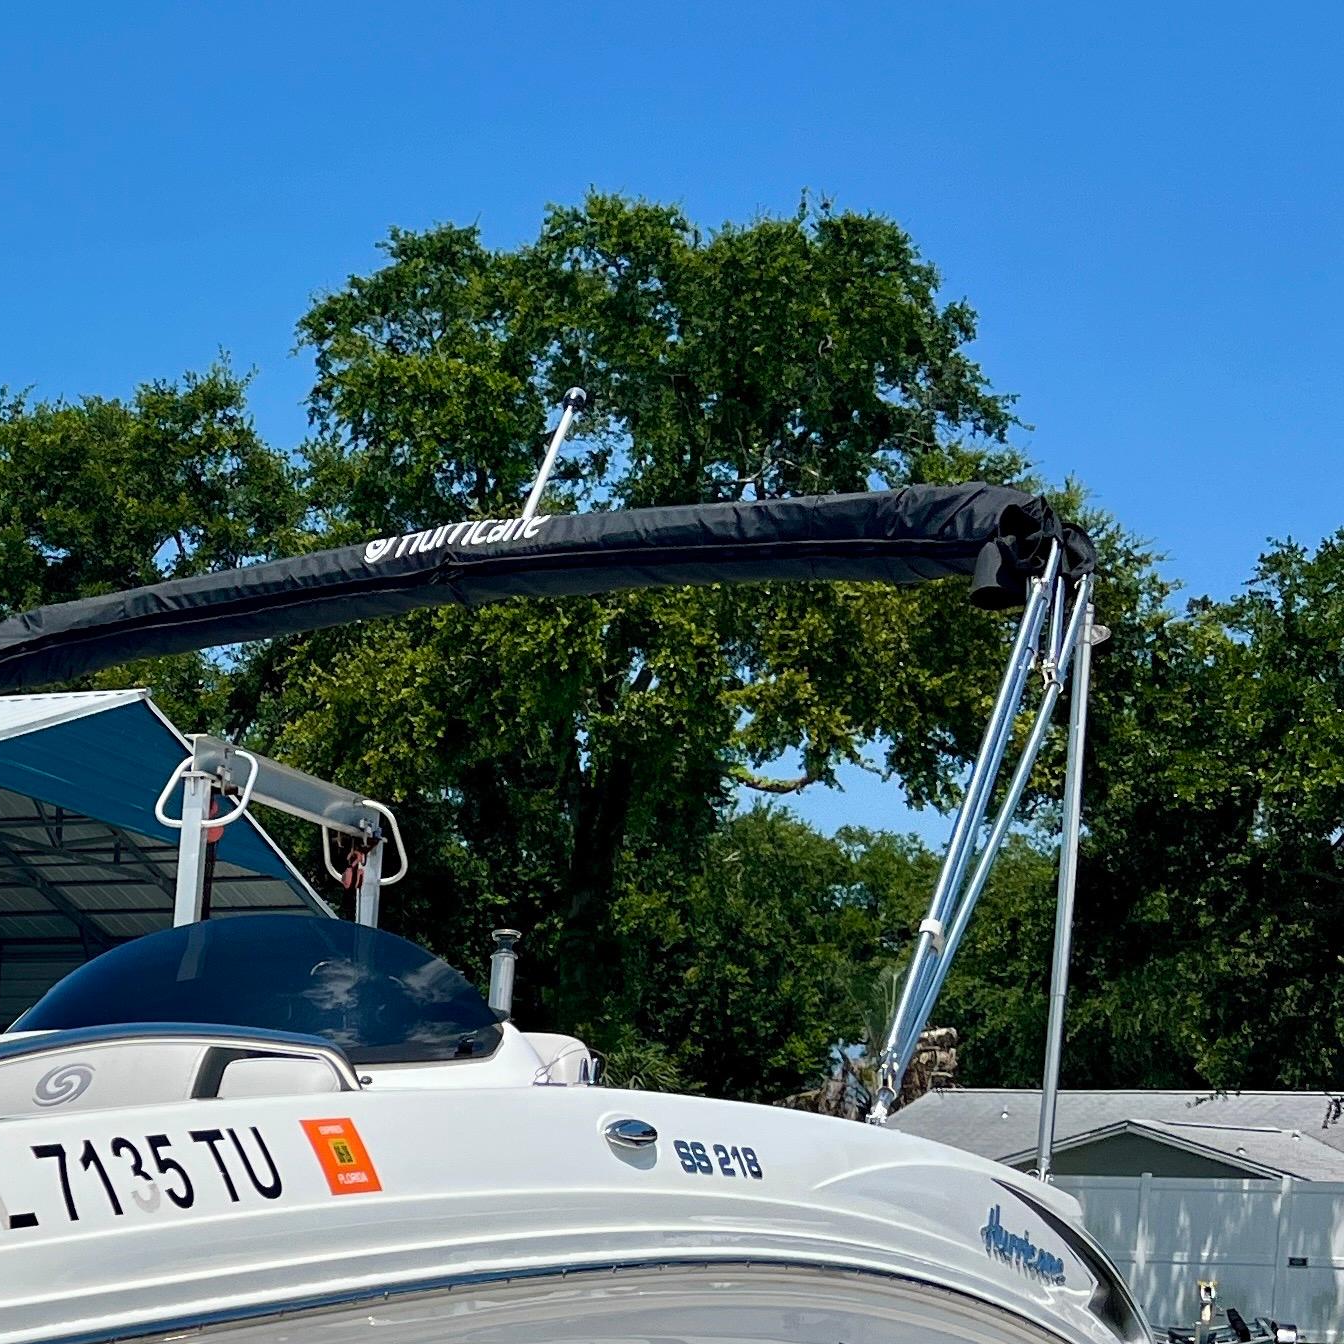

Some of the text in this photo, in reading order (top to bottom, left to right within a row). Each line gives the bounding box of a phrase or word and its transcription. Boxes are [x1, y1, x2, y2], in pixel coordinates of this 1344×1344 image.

[29, 1133, 195, 1222] 7135
[188, 1126, 283, 1203] TU
[673, 1139, 763, 1180] SS 218
